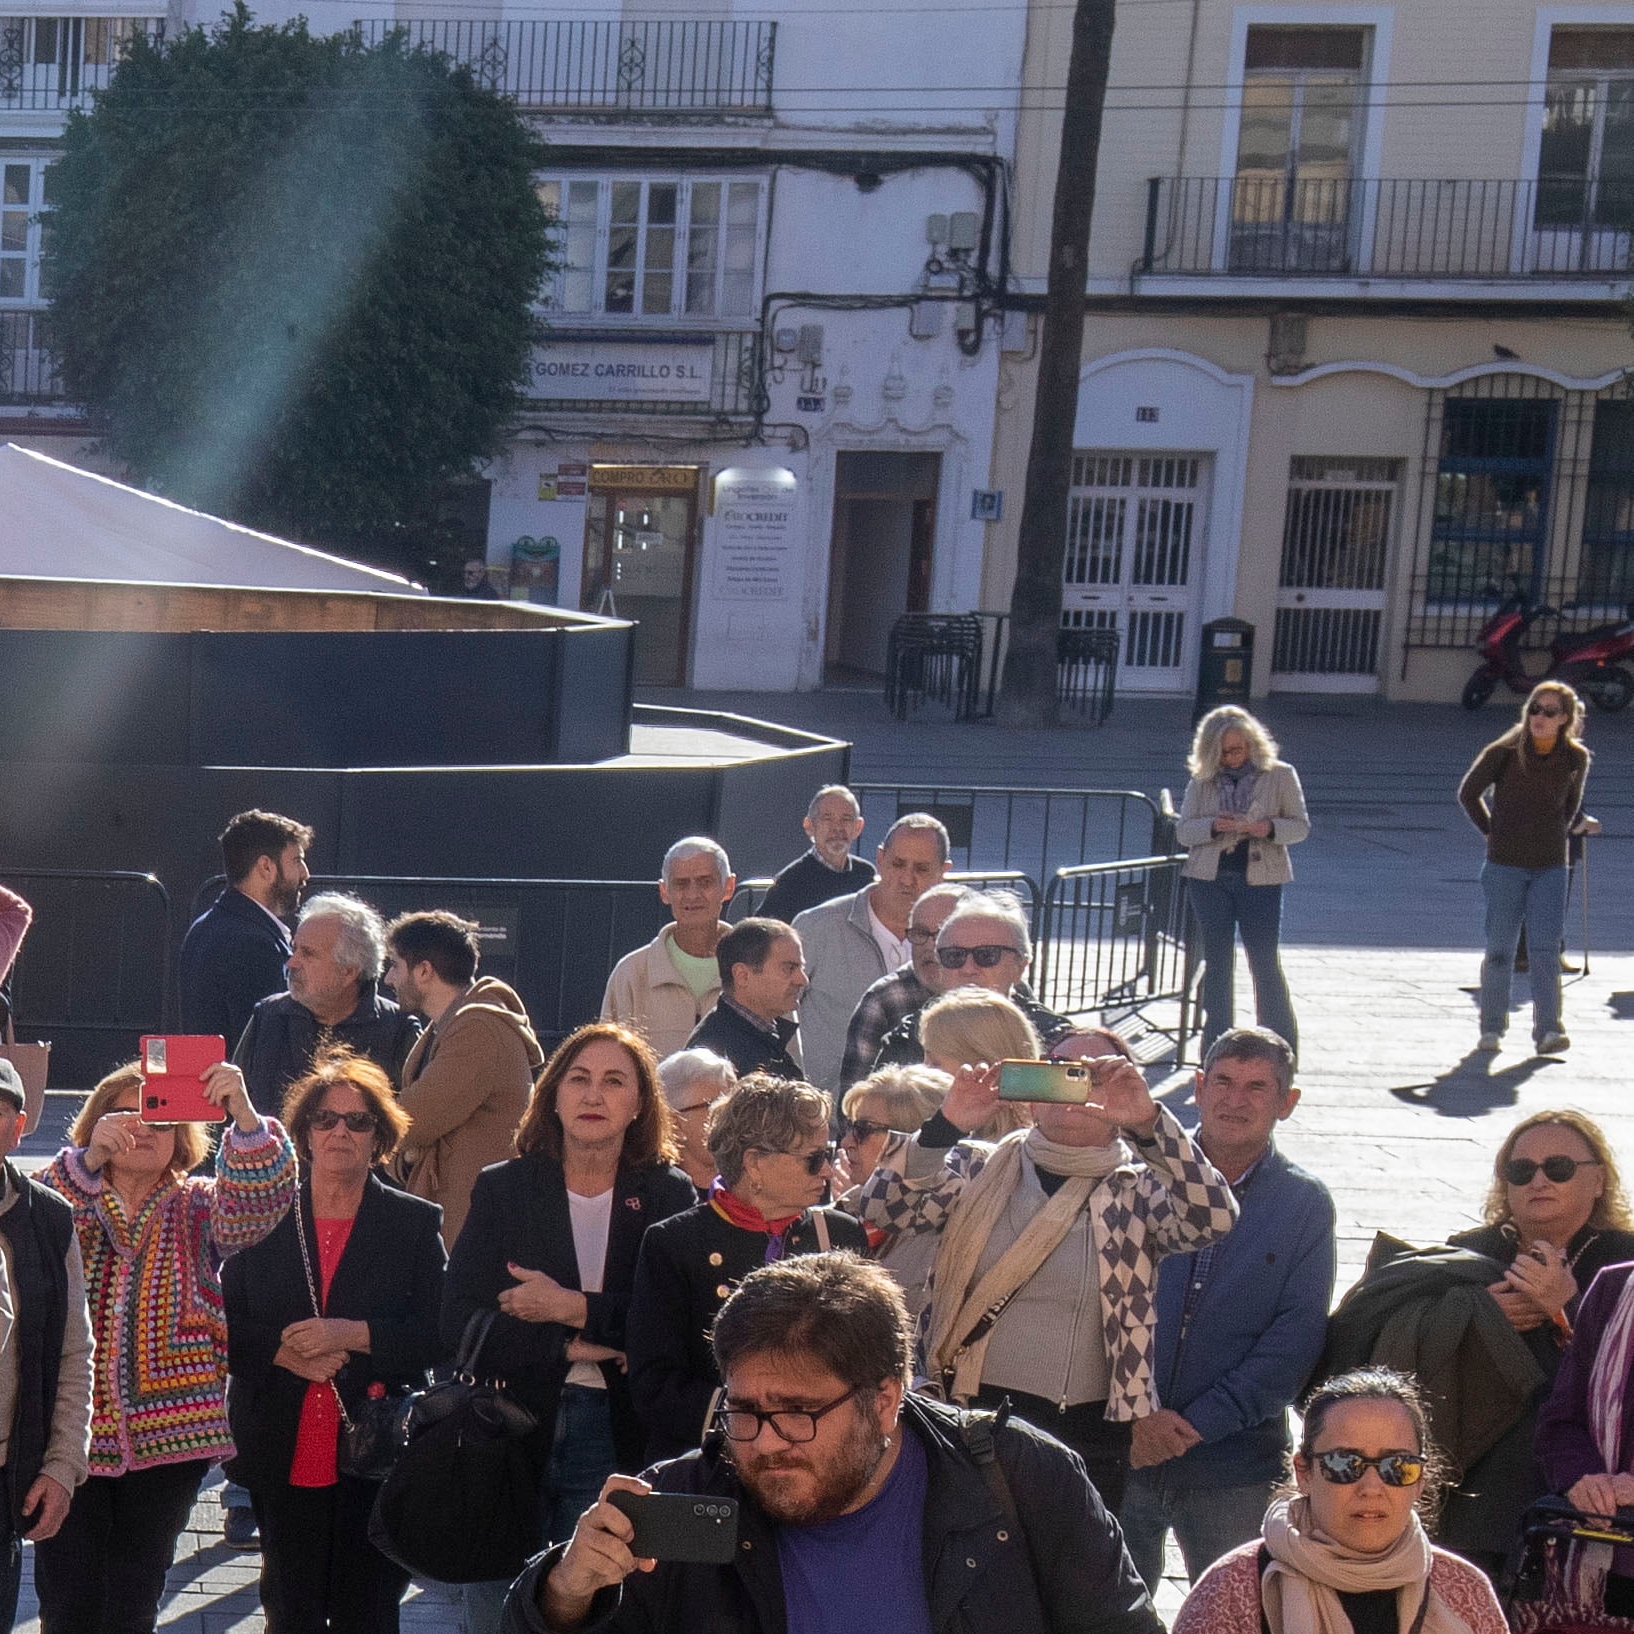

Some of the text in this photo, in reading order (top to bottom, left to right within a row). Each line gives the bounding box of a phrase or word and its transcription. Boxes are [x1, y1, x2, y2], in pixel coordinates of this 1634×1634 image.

[535, 362, 590, 377] GOMEZ
[594, 363, 671, 379] CARRILLO
[675, 364, 702, 379] S.L.
[591, 471, 645, 484] COMPRO
